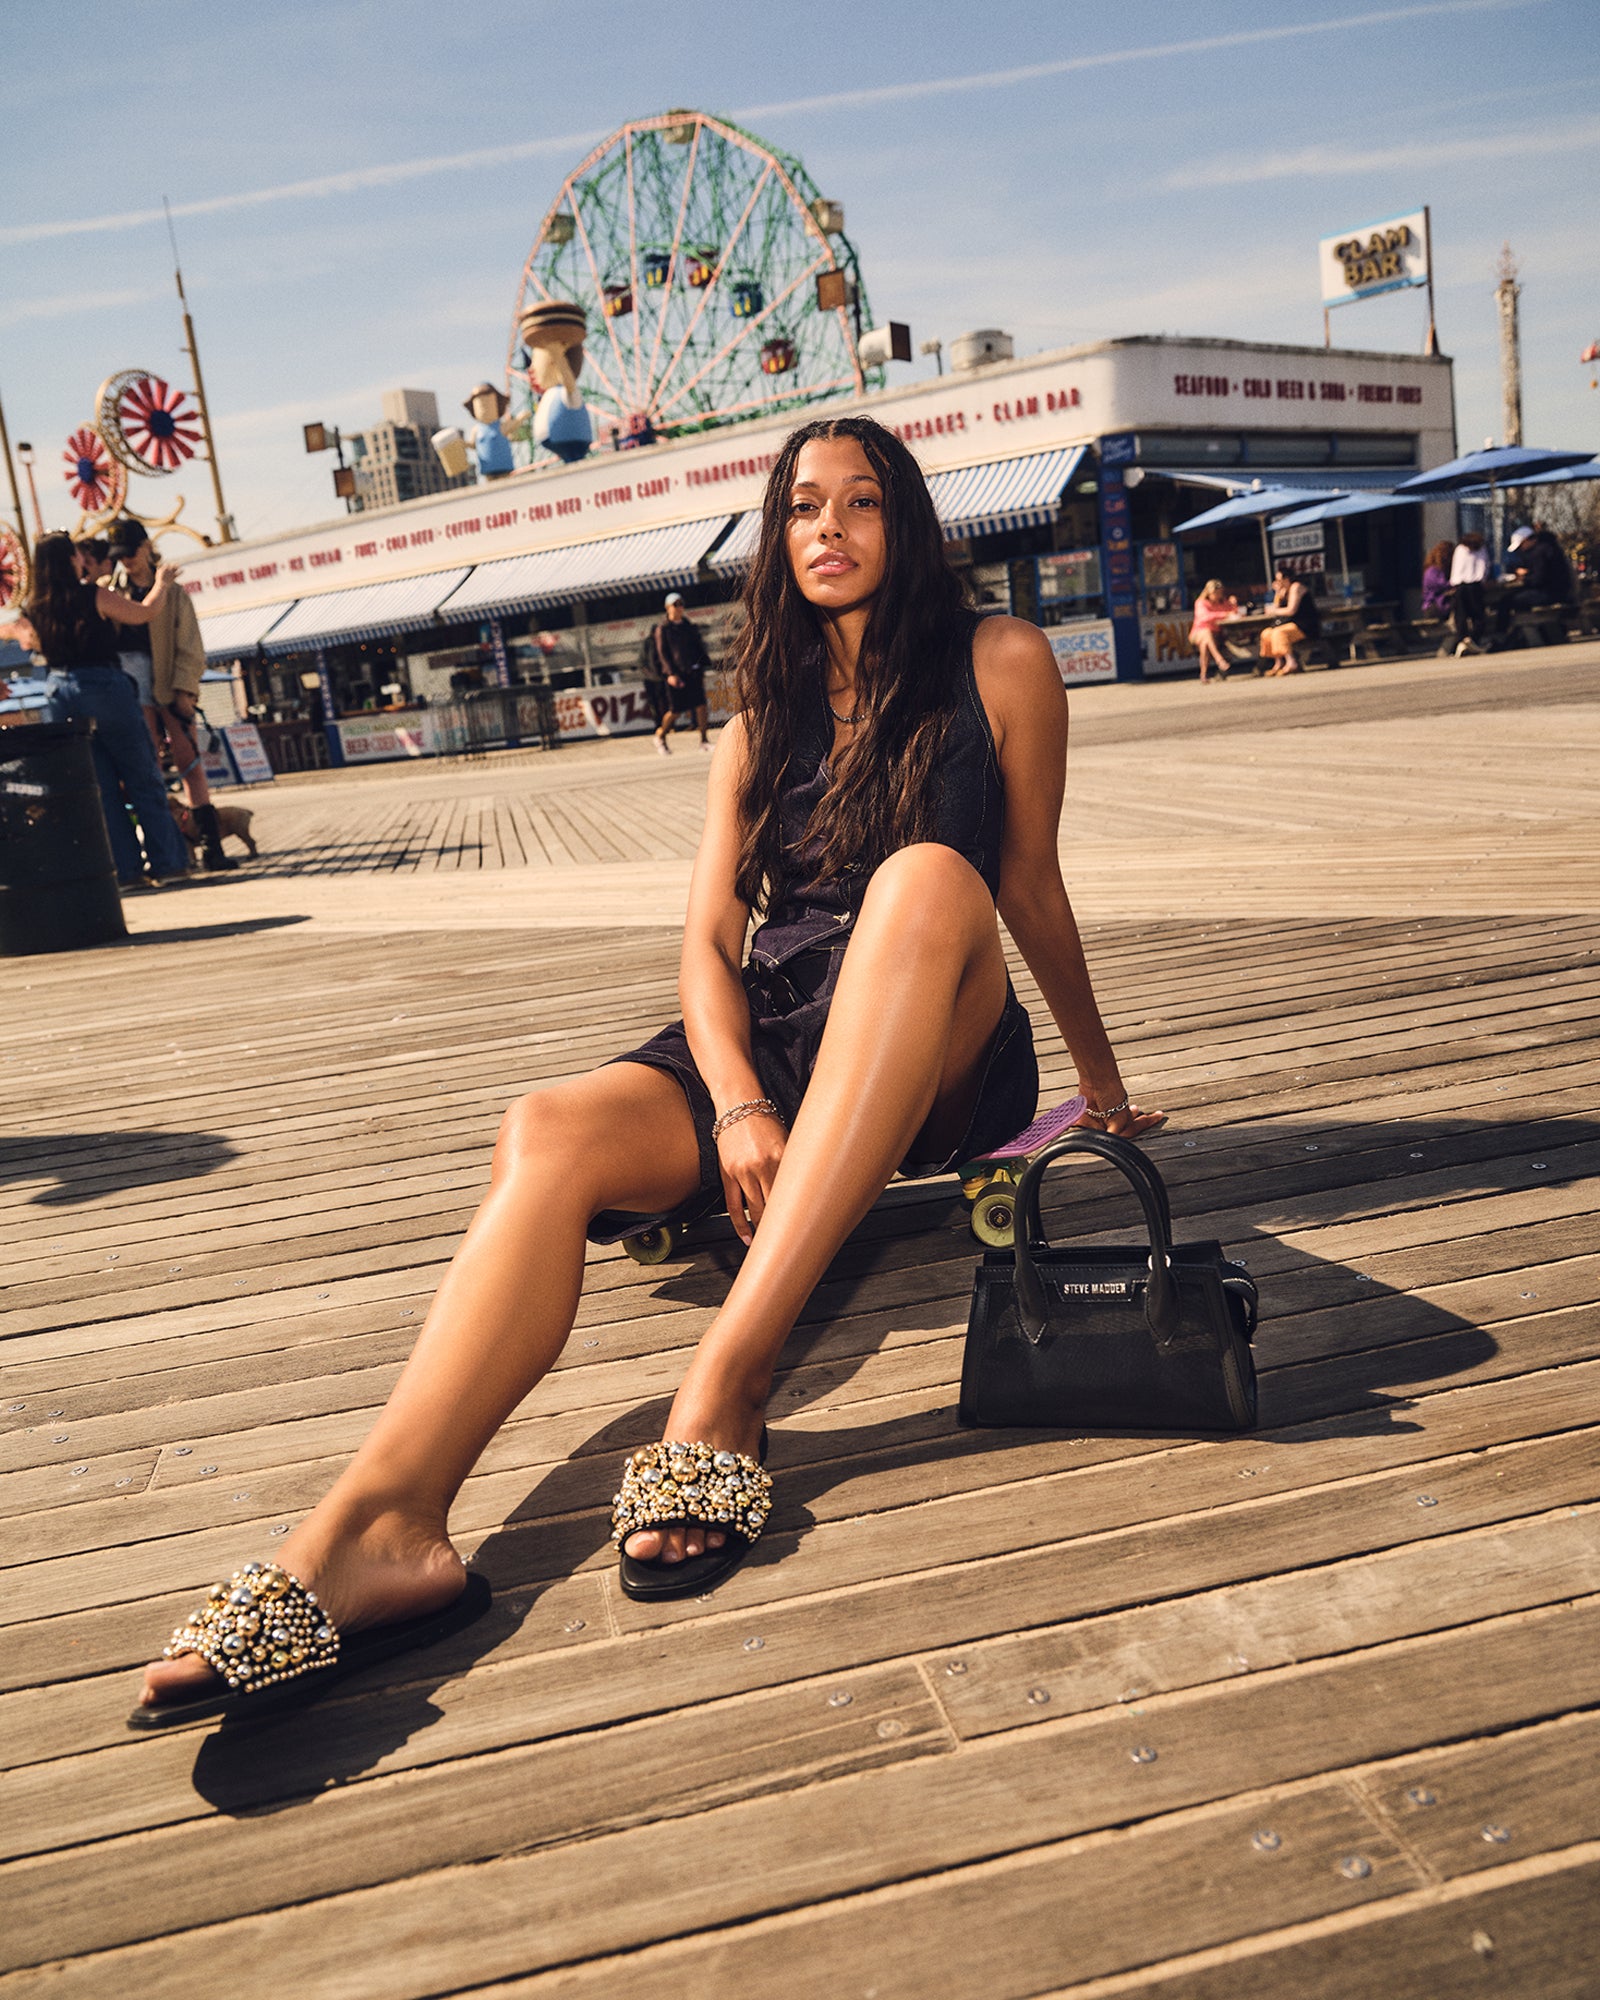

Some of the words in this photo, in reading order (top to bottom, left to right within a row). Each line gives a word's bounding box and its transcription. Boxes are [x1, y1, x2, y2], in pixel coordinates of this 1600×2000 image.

[1333, 225, 1410, 262] CLAM
[1344, 252, 1403, 287] BAR
[1175, 374, 1229, 397] SEAFOOD
[1244, 378, 1271, 399] COLD
[1276, 379, 1304, 400] BEER
[308, 548, 342, 568] CREAM
[386, 534, 408, 553] COLD
[410, 528, 434, 547] BEER
[445, 517, 481, 539] COTTON
[485, 509, 518, 530] CANDY
[528, 503, 553, 522] COLD
[555, 496, 582, 517] BEER
[594, 485, 632, 508] COTTON
[636, 476, 671, 499] CANDY
[993, 396, 1038, 423] CLAM
[1046, 387, 1080, 413] BAR
[1050, 632, 1110, 654] URGERS
[1063, 1283, 1090, 1294] STEVE
[1091, 1283, 1126, 1294] MADDEN
